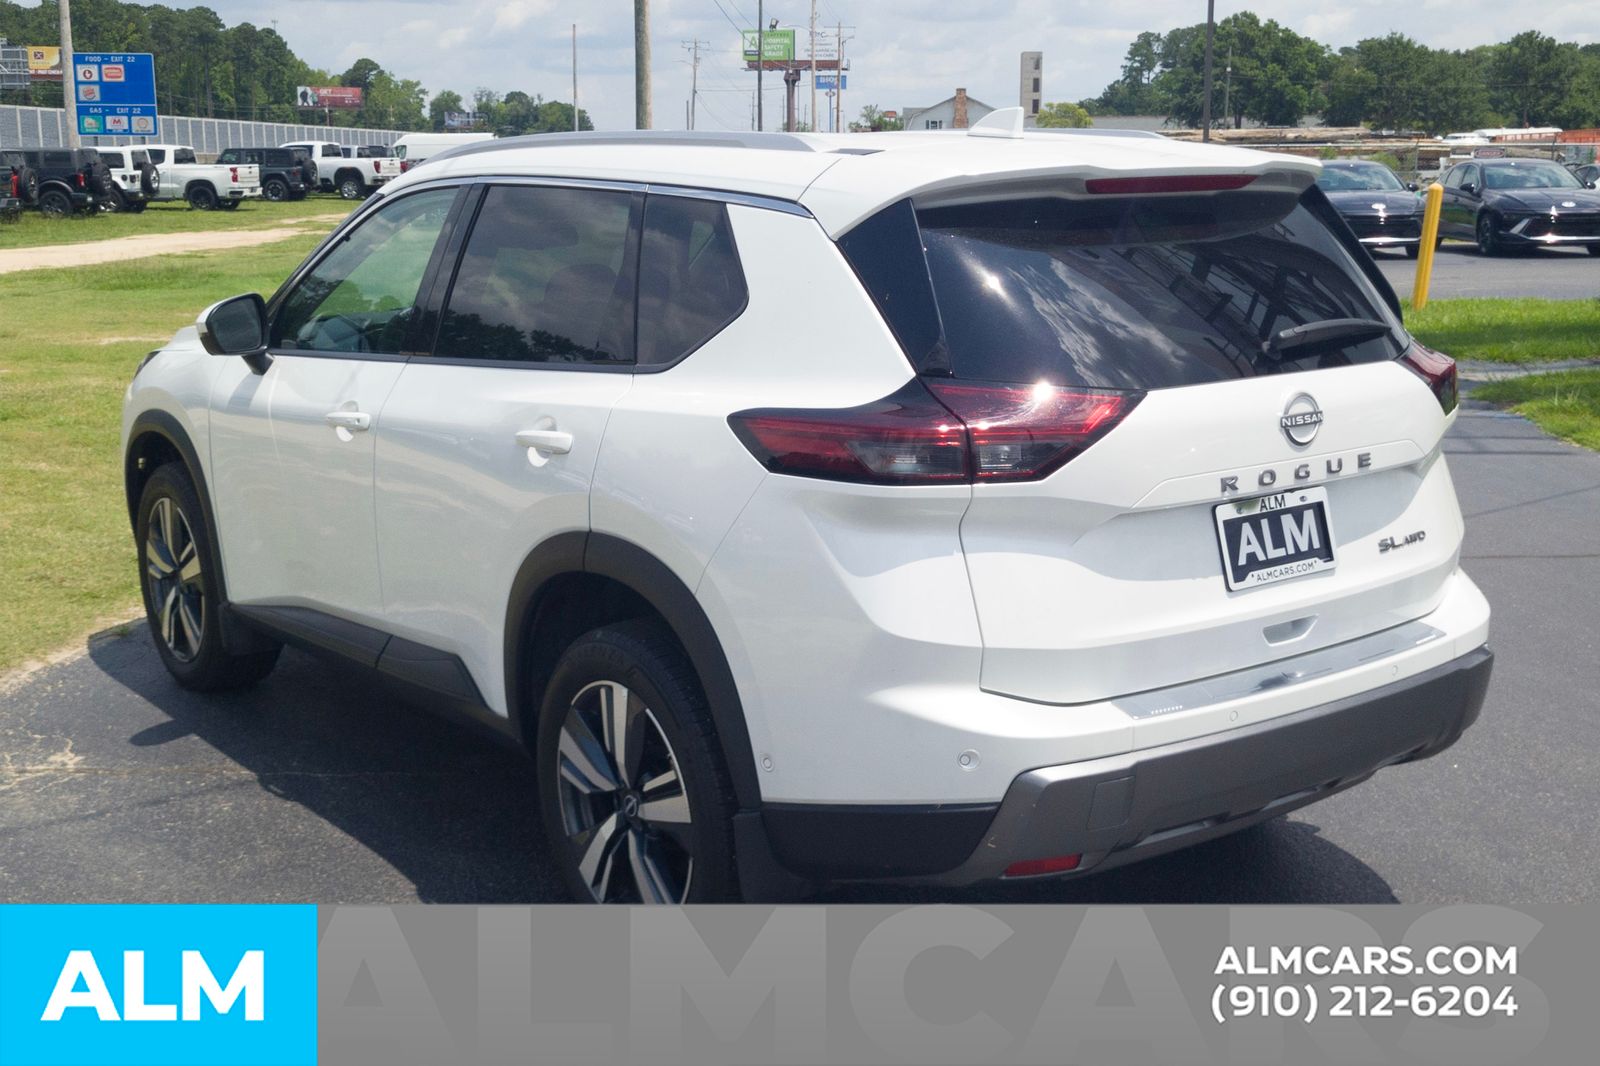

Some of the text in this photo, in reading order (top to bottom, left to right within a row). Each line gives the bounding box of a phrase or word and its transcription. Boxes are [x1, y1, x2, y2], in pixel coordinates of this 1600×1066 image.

[1281, 411, 1323, 428] NISSAN
[1220, 453, 1372, 493] ROGUE
[1259, 495, 1286, 512] ALM
[1238, 510, 1320, 566] ALM
[1378, 535, 1402, 553] SL
[1256, 562, 1315, 583] ALMCARS.COM
